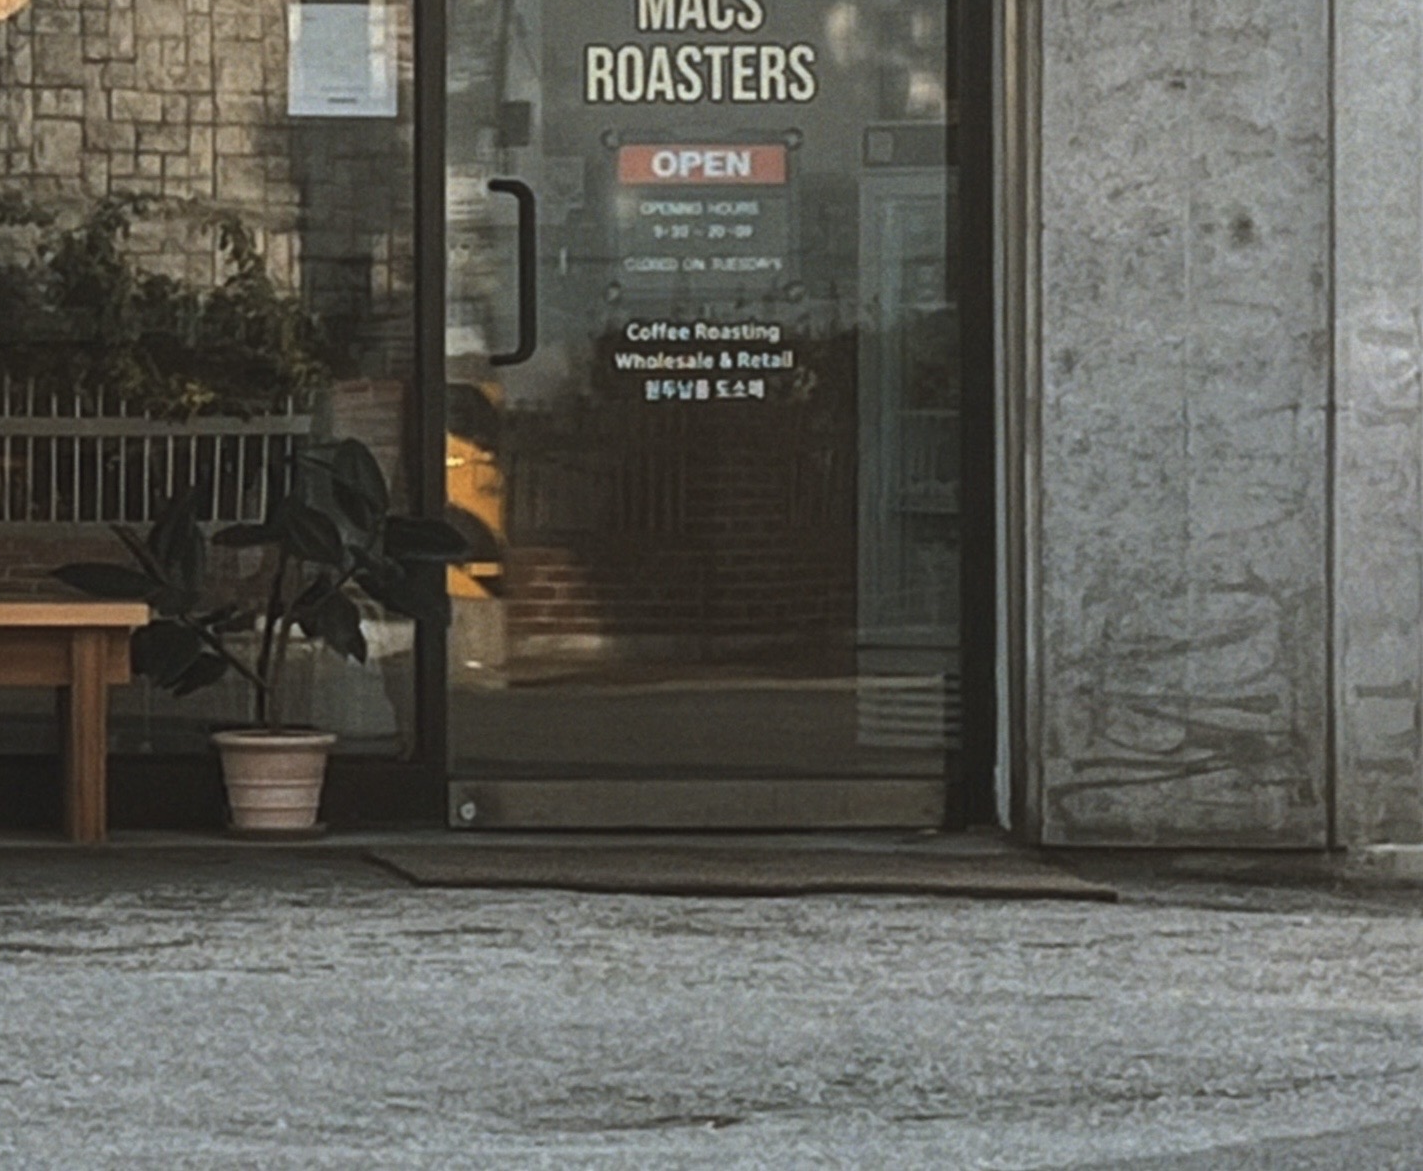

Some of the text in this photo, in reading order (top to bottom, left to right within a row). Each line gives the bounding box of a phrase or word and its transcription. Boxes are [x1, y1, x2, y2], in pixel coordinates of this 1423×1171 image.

[586, 44, 816, 102] ROASTERS
[651, 150, 751, 178] OPEN
[626, 322, 781, 344] Coffee Roasting
[615, 350, 794, 370] Wholesale & Retail
